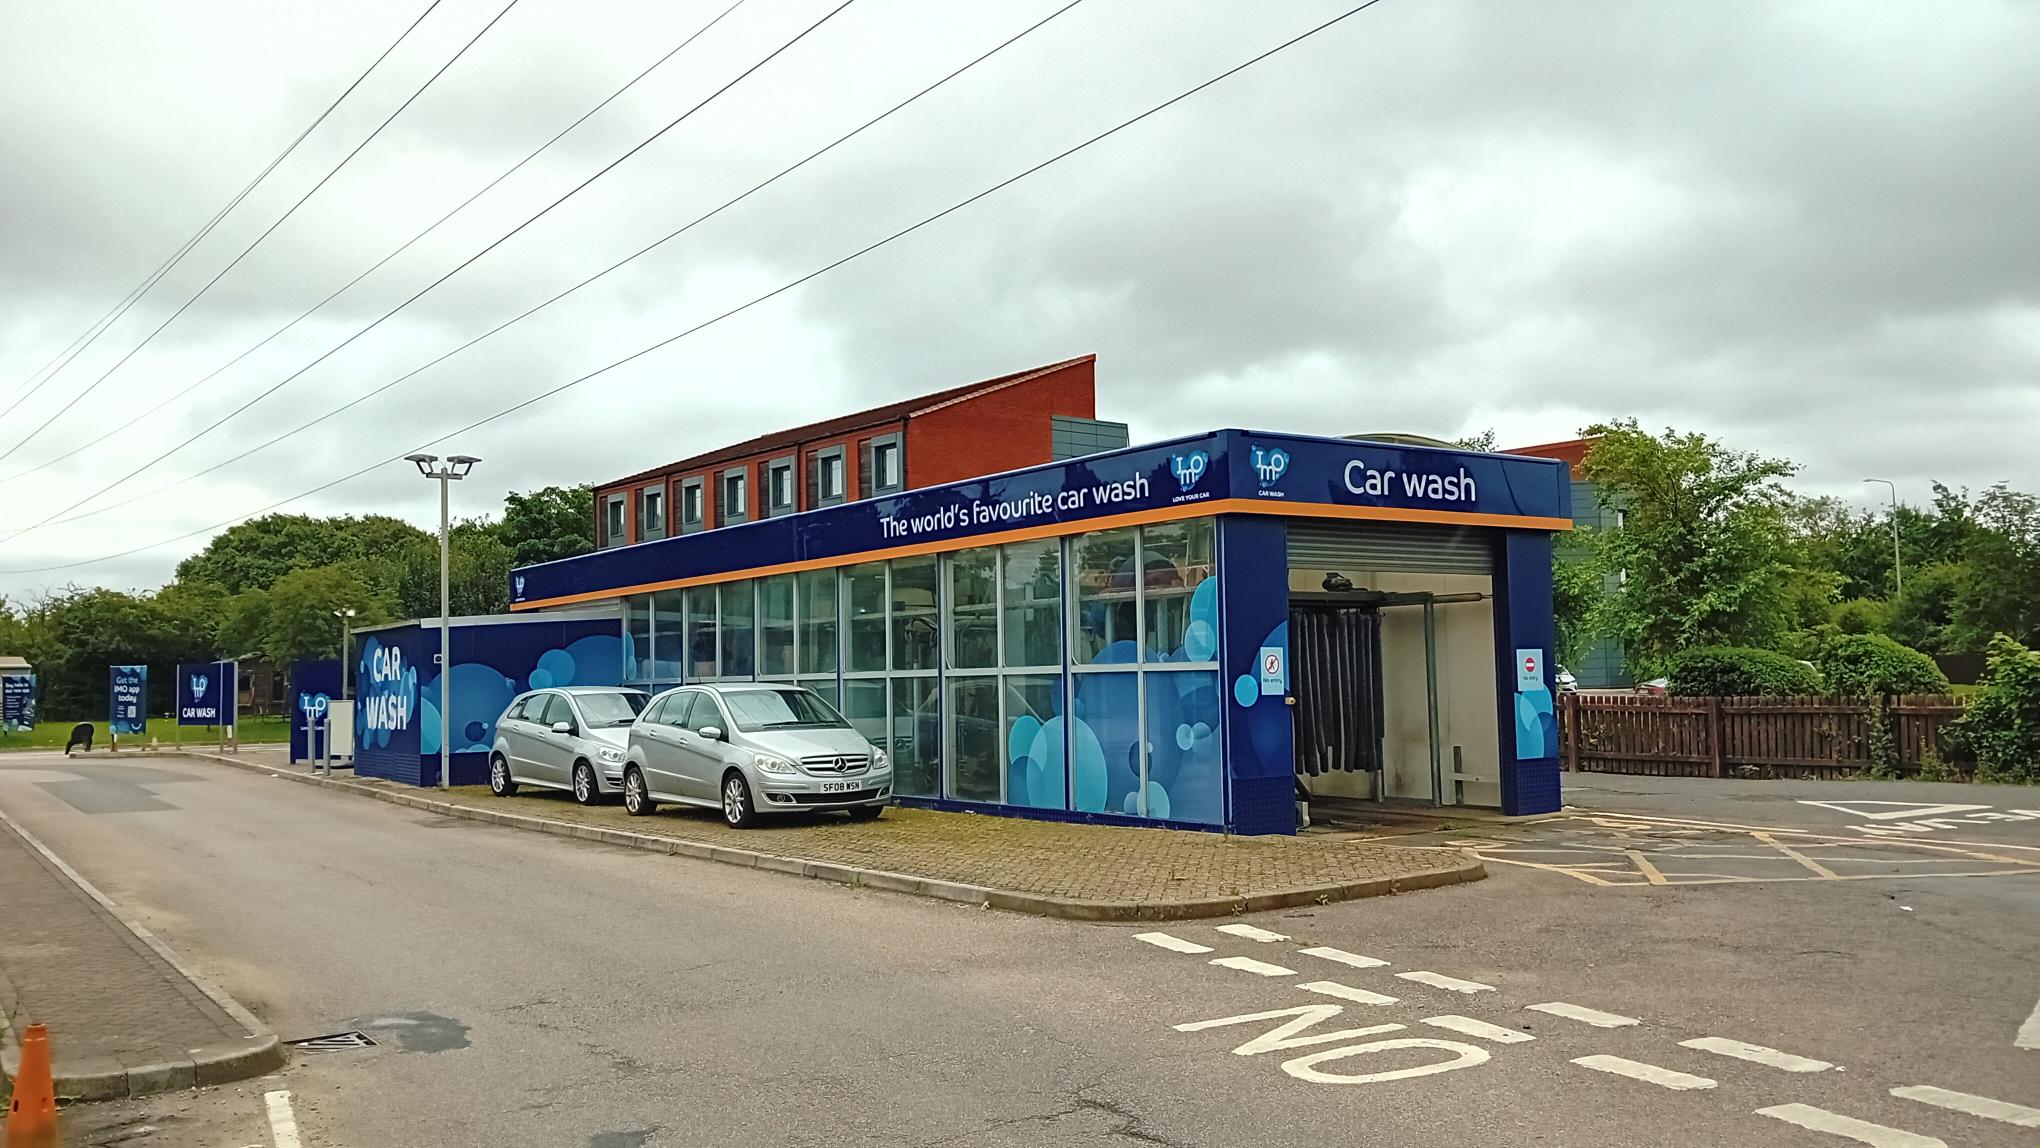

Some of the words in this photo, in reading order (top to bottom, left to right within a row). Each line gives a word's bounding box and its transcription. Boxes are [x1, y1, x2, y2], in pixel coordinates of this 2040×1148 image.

[1343, 459, 1396, 496] Car
[1402, 467, 1476, 502] wash
[1185, 493, 1199, 501] YOUR
[1199, 491, 1210, 499] CAR
[1269, 490, 1285, 498] WASH
[879, 517, 908, 539] The
[911, 503, 970, 534] world's
[973, 490, 1053, 525] favourite
[1057, 488, 1088, 512] car
[1092, 471, 1149, 505] wash
[373, 646, 401, 683] CAR
[116, 676, 127, 684] Get
[128, 676, 138, 684] the
[114, 685, 128, 693] IMO
[129, 686, 140, 695] app
[118, 693, 137, 704] today
[182, 707, 194, 718] CAR
[194, 707, 216, 718] WASH
[365, 694, 407, 731] WASH
[823, 782, 845, 792] SF08
[846, 781, 860, 791] WSN
[1172, 1004, 1492, 1084] NO
